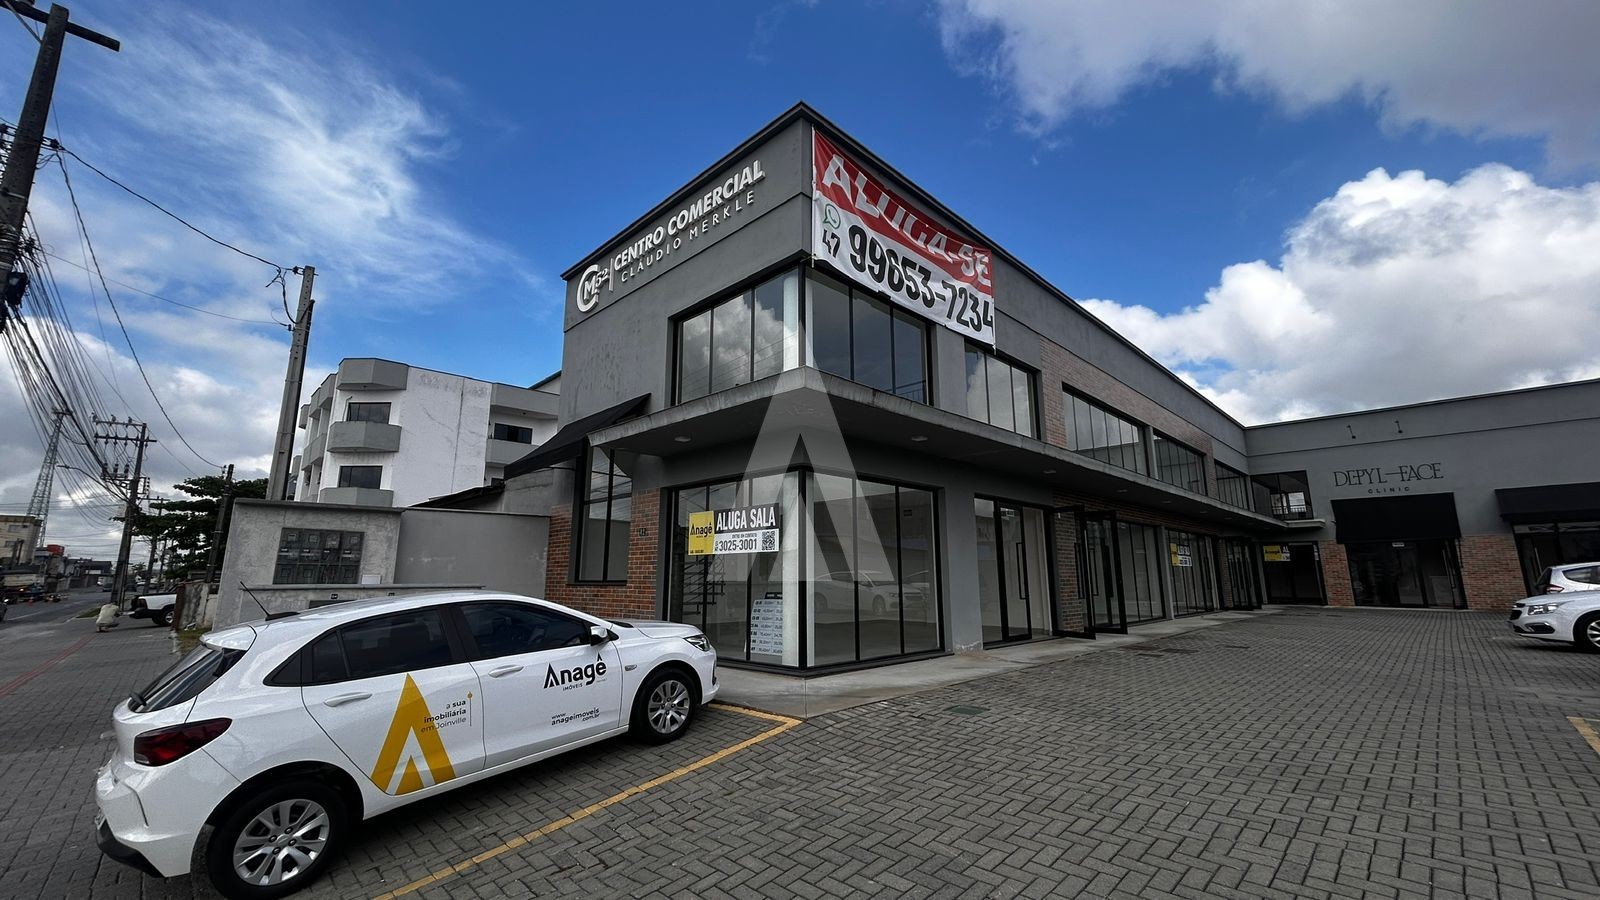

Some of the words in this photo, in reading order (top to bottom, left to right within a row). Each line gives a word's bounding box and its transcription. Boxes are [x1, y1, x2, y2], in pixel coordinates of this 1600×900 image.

[614, 227, 664, 271] CENTRO
[667, 160, 766, 236] COMERCIAL
[621, 237, 682, 283] CLAUDIO
[690, 190, 755, 240] MERKLE
[822, 228, 841, 258] 47
[848, 225, 993, 332] 99653-7234
[1367, 486, 1411, 494] CLINIC
[716, 510, 747, 531] ALUGA
[750, 507, 776, 528] SALA
[719, 538, 757, 551] 3025-3001
[544, 652, 607, 689] Anagê
[452, 700, 466, 708] sua
[421, 725, 434, 733] em
[435, 717, 467, 730] Joinville
[423, 708, 467, 724] imobiliária
